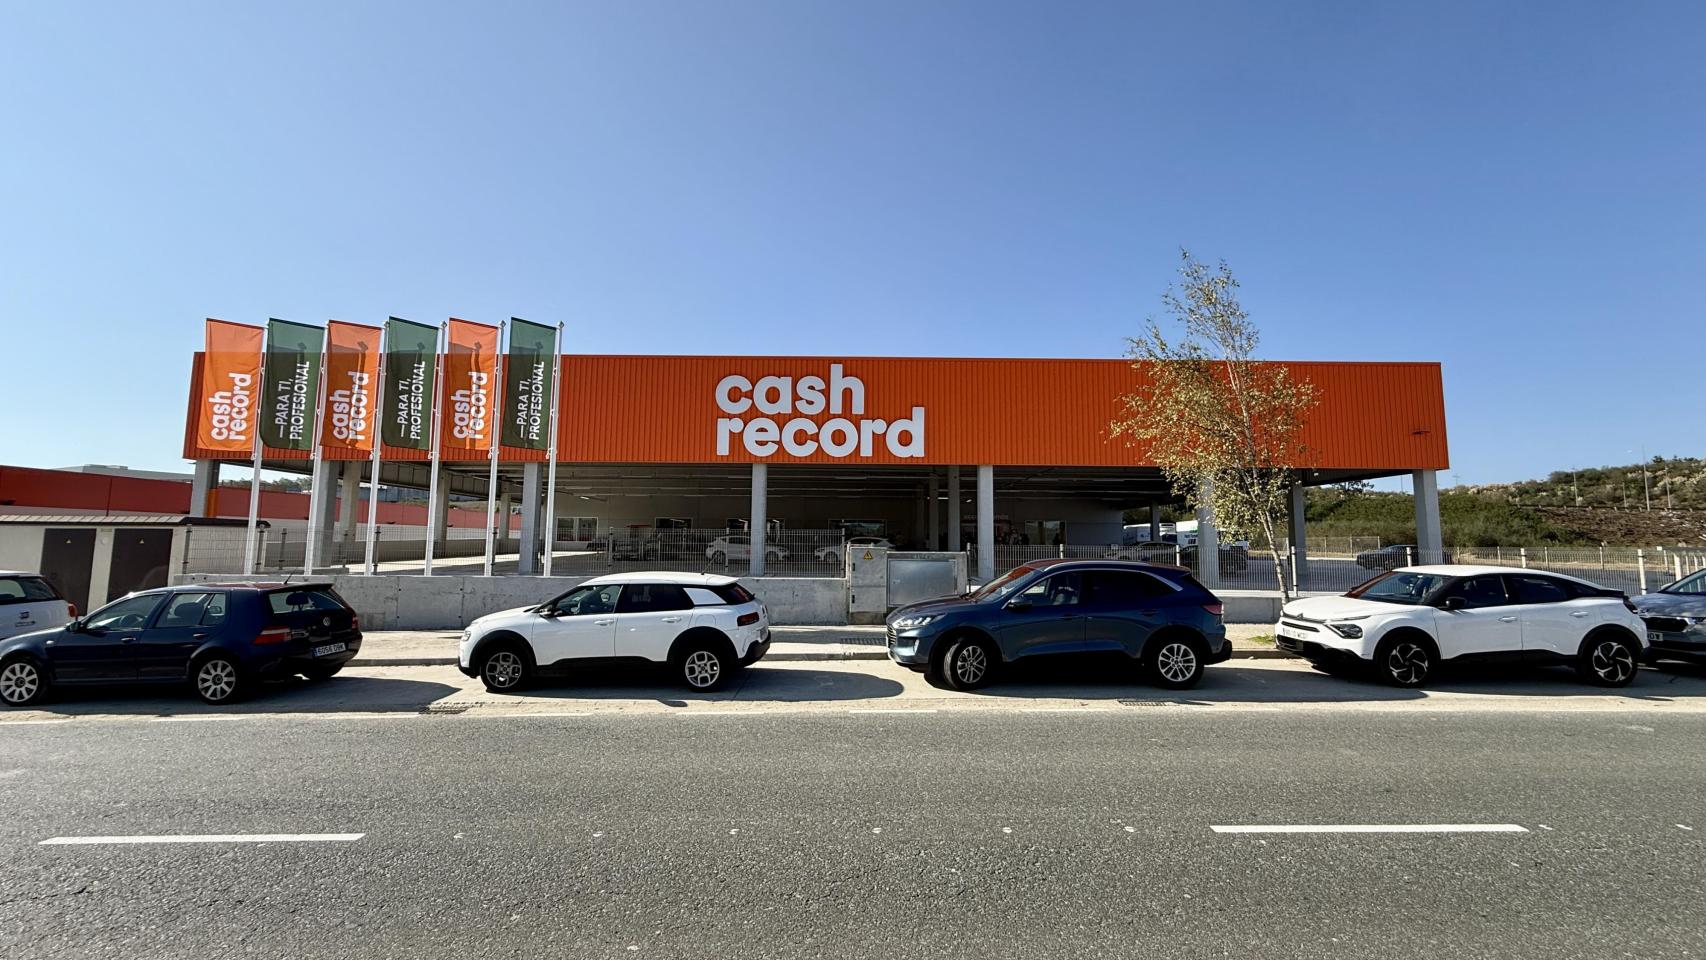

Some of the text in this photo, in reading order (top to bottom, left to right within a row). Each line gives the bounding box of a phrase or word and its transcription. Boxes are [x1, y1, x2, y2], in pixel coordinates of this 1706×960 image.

[229, 372, 251, 440] record
[278, 378, 293, 392] TI,
[289, 361, 310, 440] PROFESIONAL
[348, 371, 369, 440] record
[398, 378, 412, 391] TI,
[410, 361, 426, 440] PROFESIONAL
[467, 371, 488, 439] record
[519, 378, 532, 392] TI,
[528, 361, 545, 440] PROFESIONAL
[715, 363, 865, 415] cash
[208, 391, 231, 440] cash
[330, 389, 351, 439] cash
[450, 389, 471, 439] cash
[716, 406, 925, 458] record
